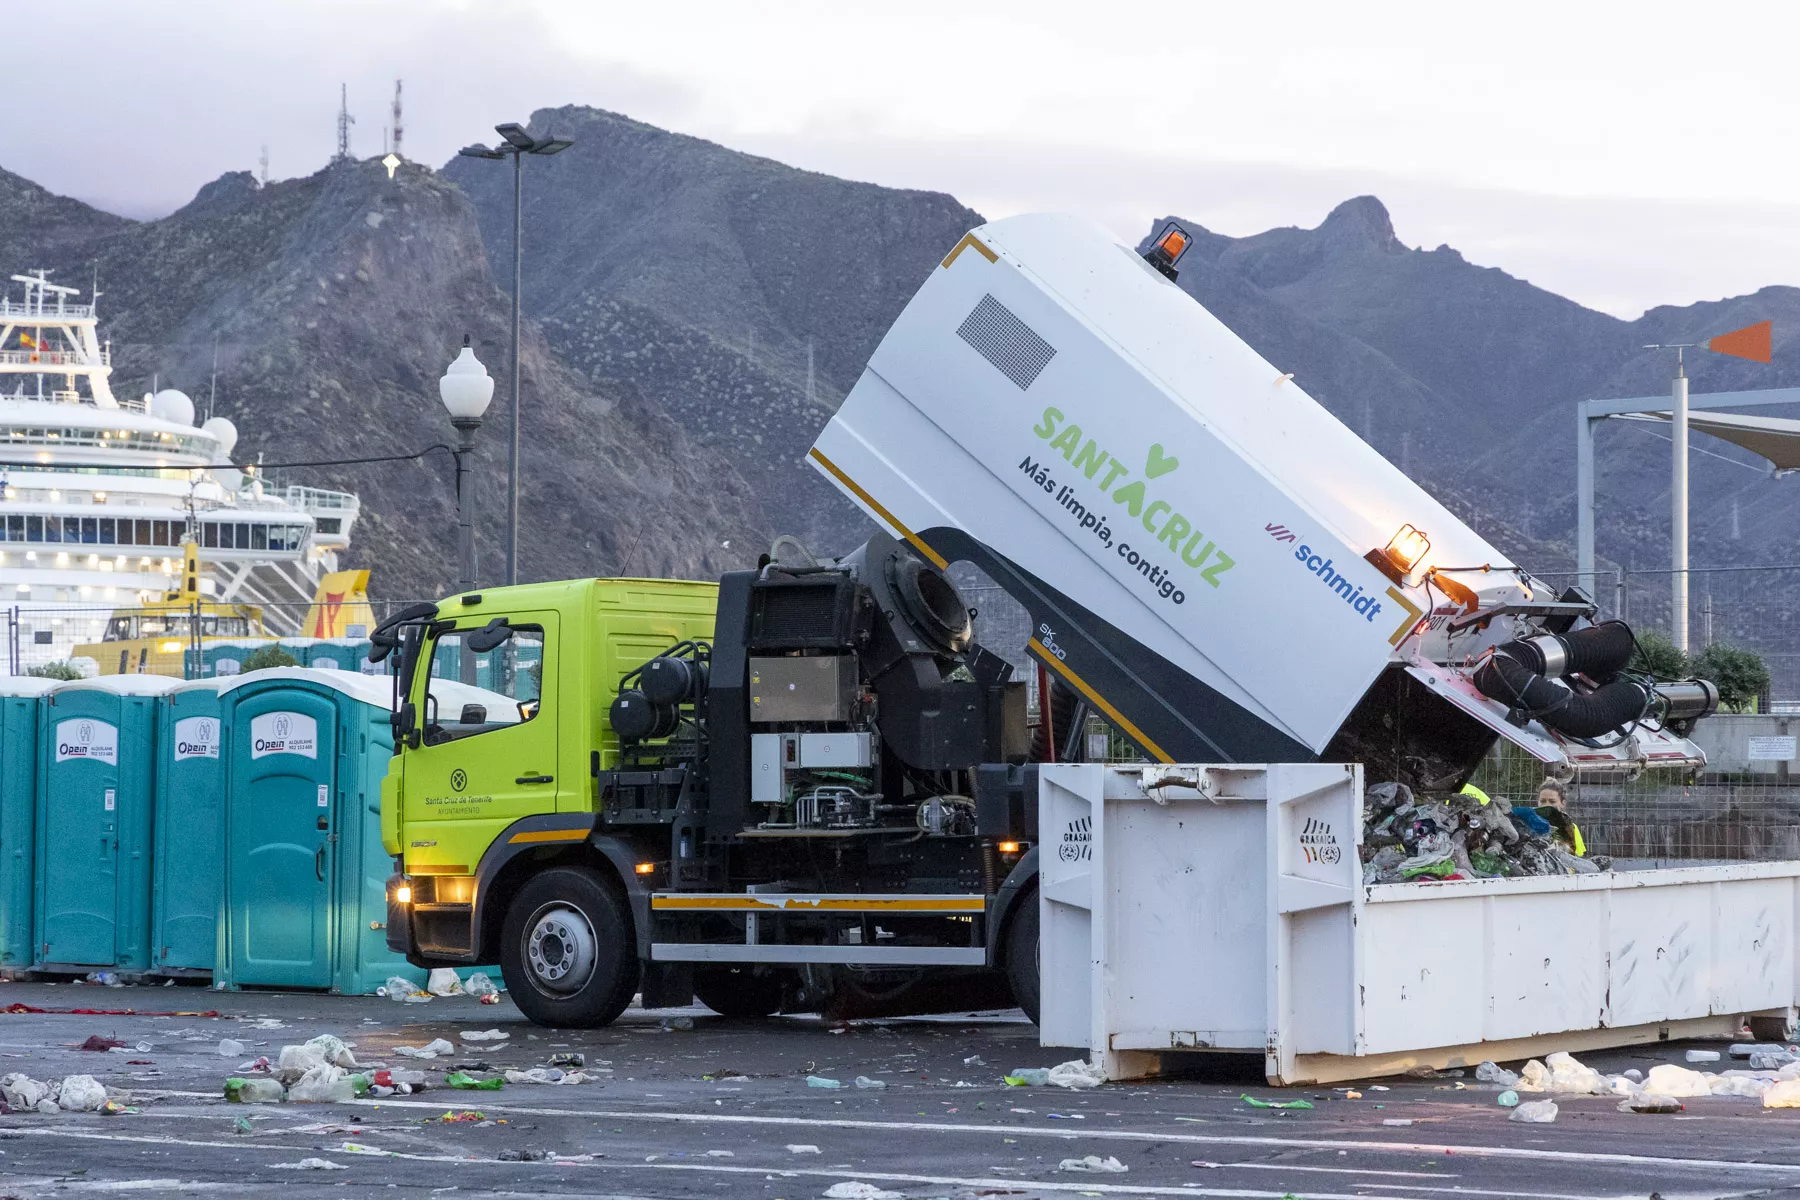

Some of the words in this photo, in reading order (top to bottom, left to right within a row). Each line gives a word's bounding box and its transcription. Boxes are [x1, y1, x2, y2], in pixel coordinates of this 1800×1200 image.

[1018, 455, 1056, 493] Más
[1055, 485, 1113, 549] limpia,
[1117, 543, 1185, 604] contigo
[1295, 544, 1381, 622] schmidt
[1040, 623, 1056, 640] SK
[60, 743, 87, 755] Opein
[178, 741, 206, 754] Opein
[255, 739, 284, 751] Opein
[425, 797, 442, 805] Santa
[444, 796, 457, 804] Cruz
[468, 795, 492, 803] Tenerife
[438, 806, 480, 815] AYUNTAMIENTO
[1300, 834, 1336, 844] GRASAICA
